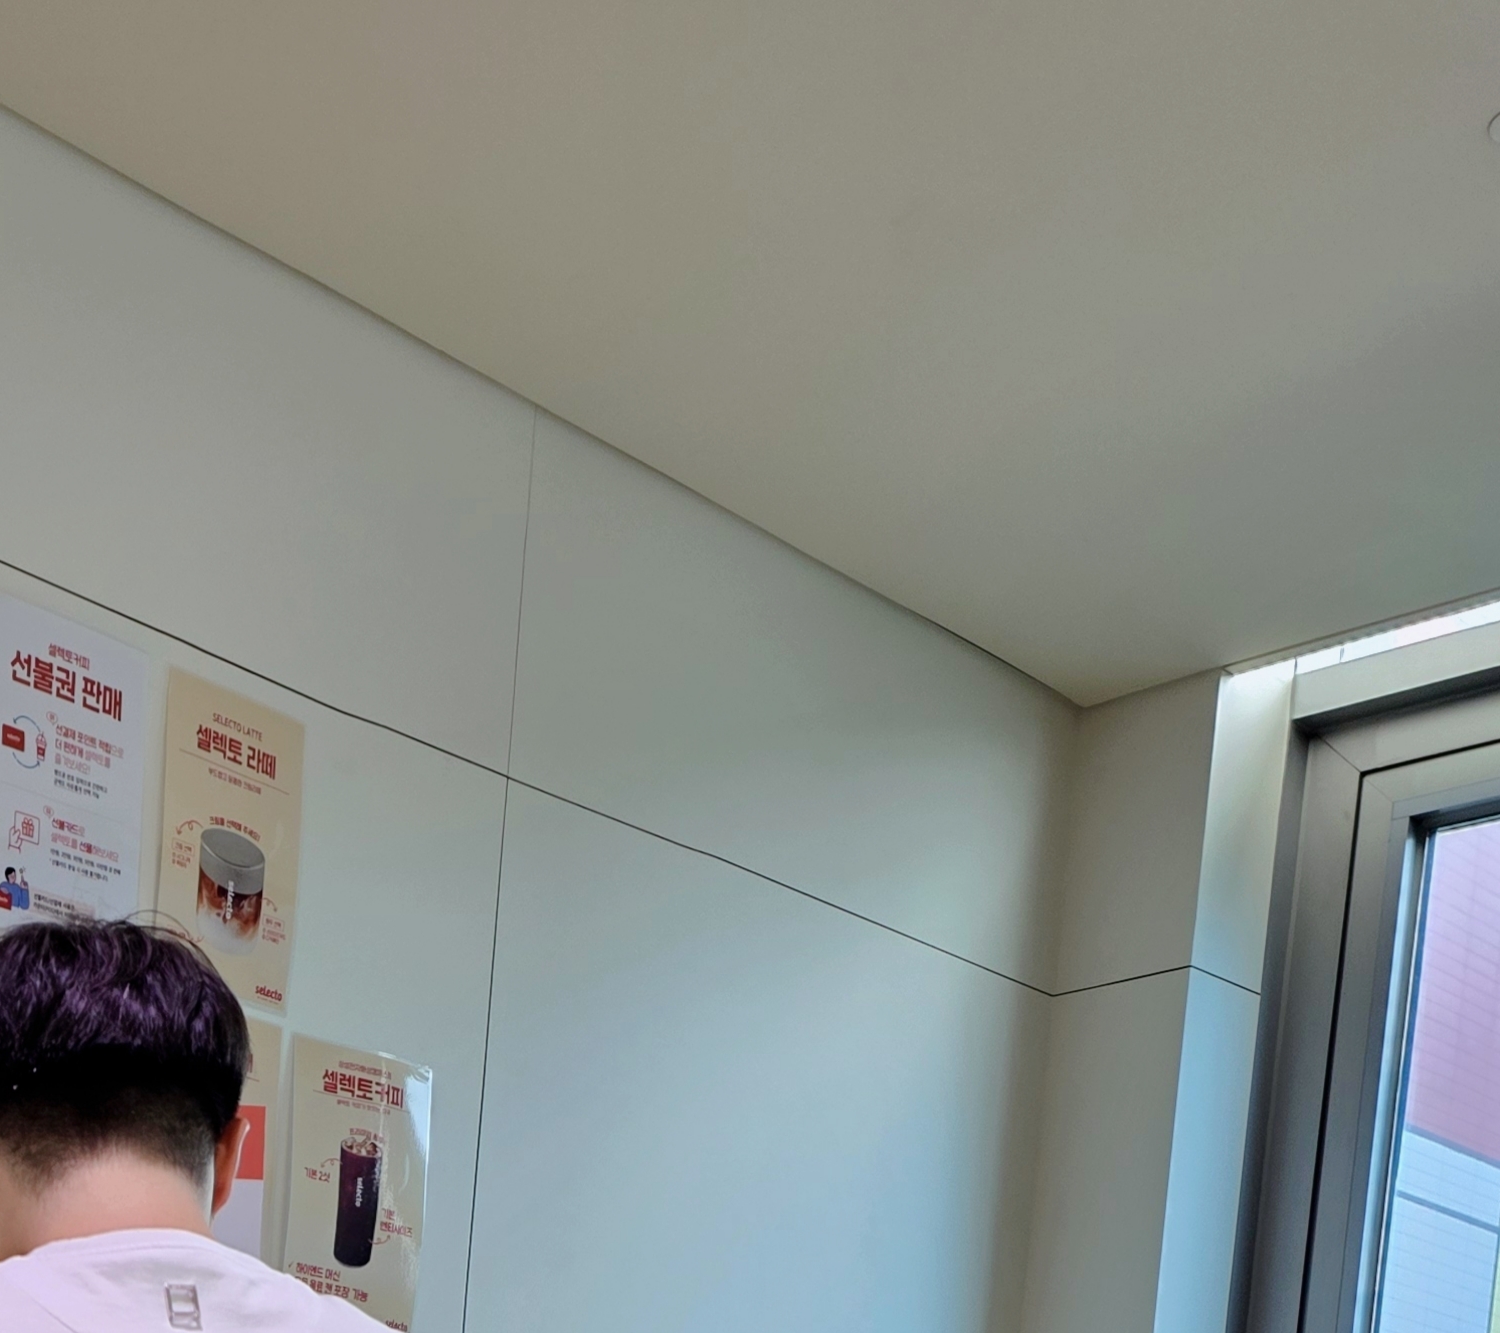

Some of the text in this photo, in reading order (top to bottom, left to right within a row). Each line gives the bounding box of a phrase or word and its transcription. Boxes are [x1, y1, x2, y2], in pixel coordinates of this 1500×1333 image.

[10, 650, 122, 722] 선불권 판매
[212, 712, 263, 742] SELECTO LATTE
[197, 723, 276, 780] 셀렉토 라떼
[255, 985, 282, 1002] selecto
[323, 1069, 404, 1109] 셀렉토커피
